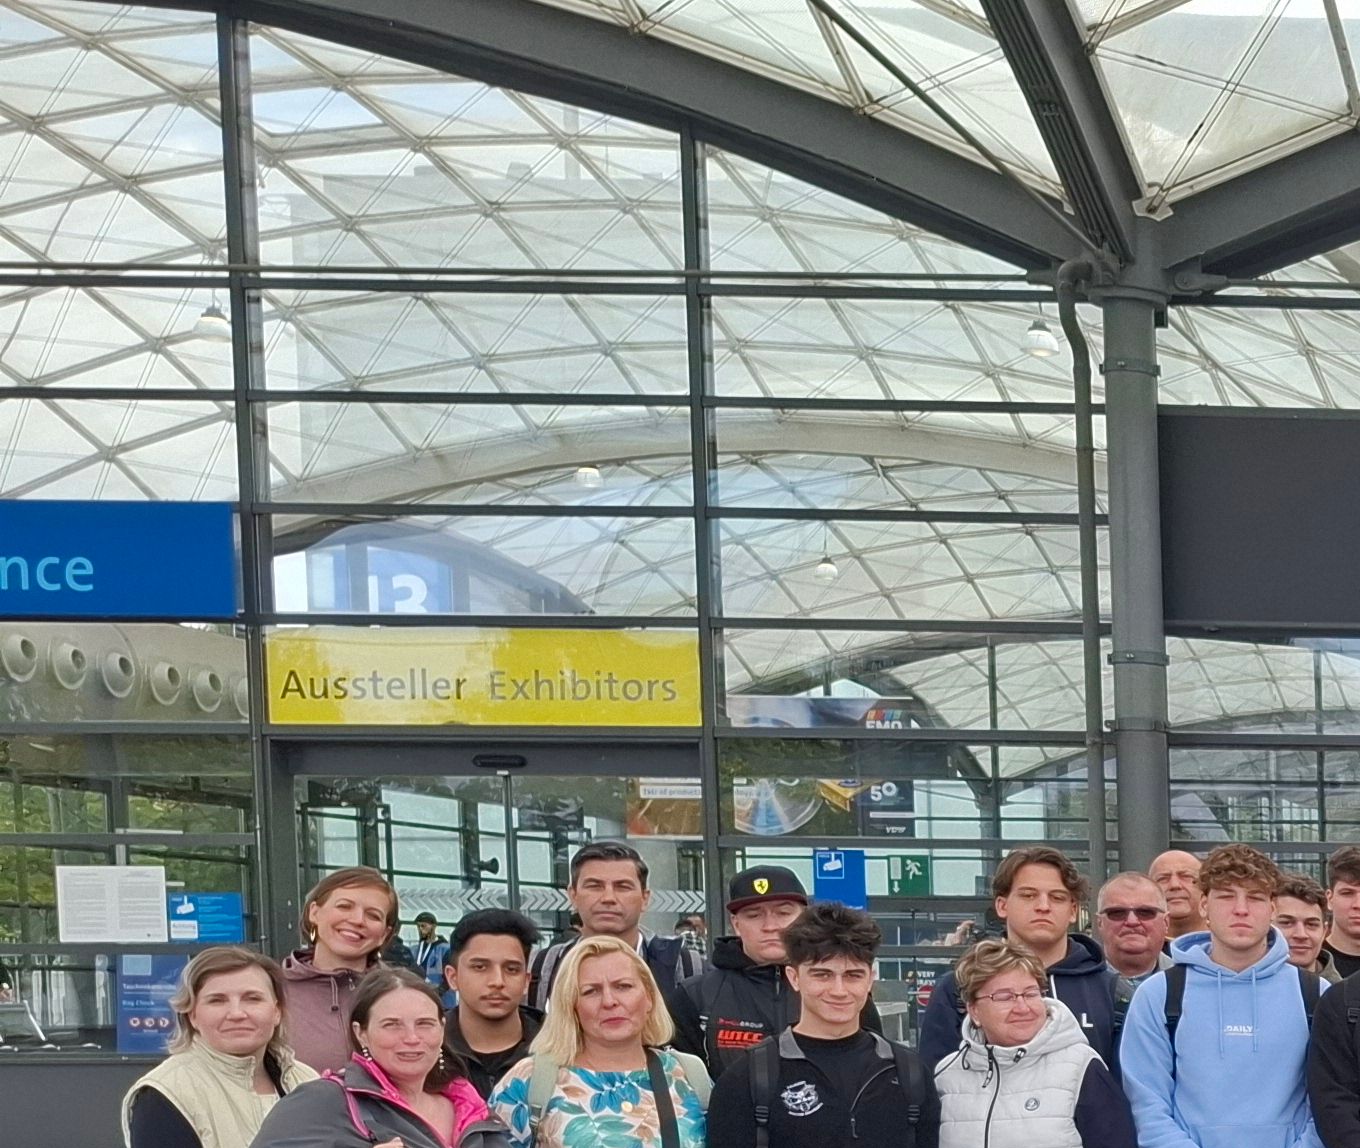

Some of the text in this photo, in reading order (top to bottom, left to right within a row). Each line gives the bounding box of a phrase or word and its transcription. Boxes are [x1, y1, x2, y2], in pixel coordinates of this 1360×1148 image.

[0, 556, 94, 592] nce
[280, 668, 677, 702] Aussteller Exhibitors
